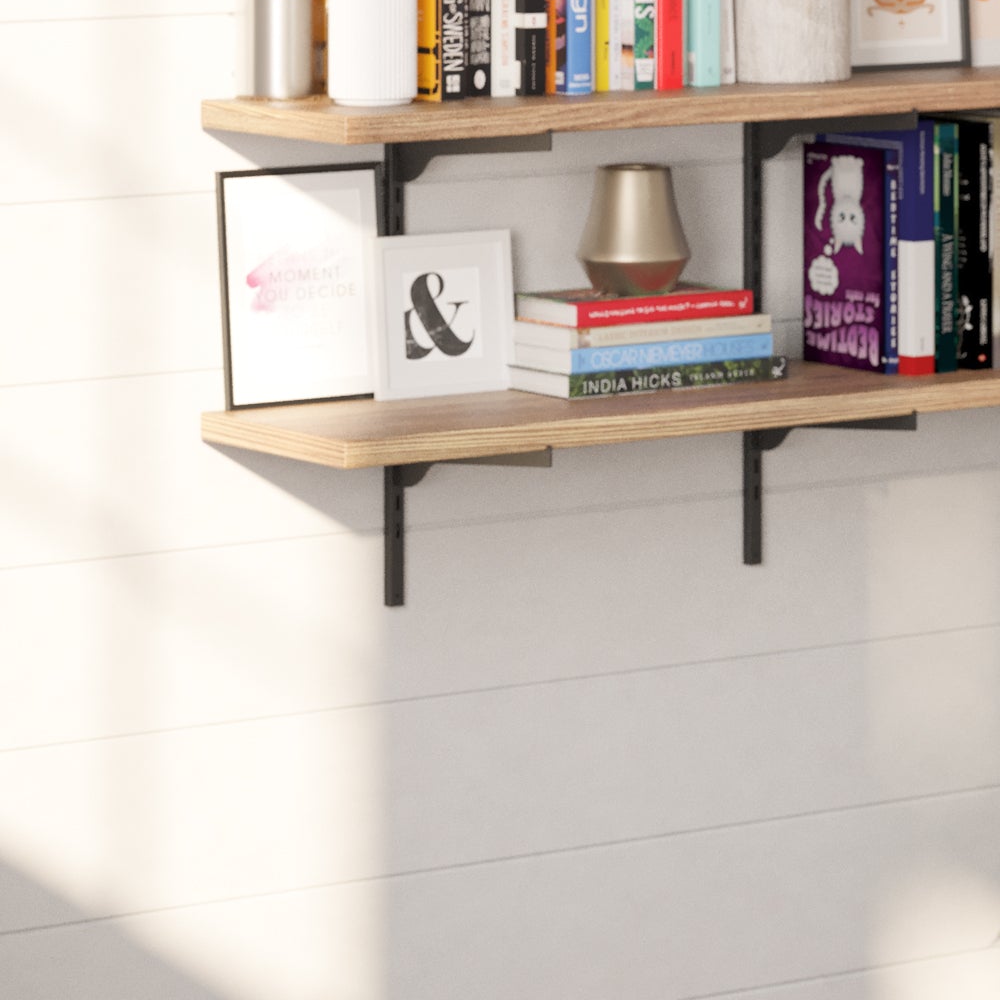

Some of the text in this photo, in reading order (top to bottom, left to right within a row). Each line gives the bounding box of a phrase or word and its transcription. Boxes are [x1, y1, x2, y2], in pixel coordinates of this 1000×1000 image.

[442, 11, 465, 72] SWEDEN
[269, 265, 341, 284] MOMENT
[295, 281, 357, 302] DECIDE
[404, 272, 476, 360] &
[804, 294, 876, 329] STORIES
[806, 324, 880, 368] BEDTIME
[582, 371, 683, 394] INDIA HICKS
